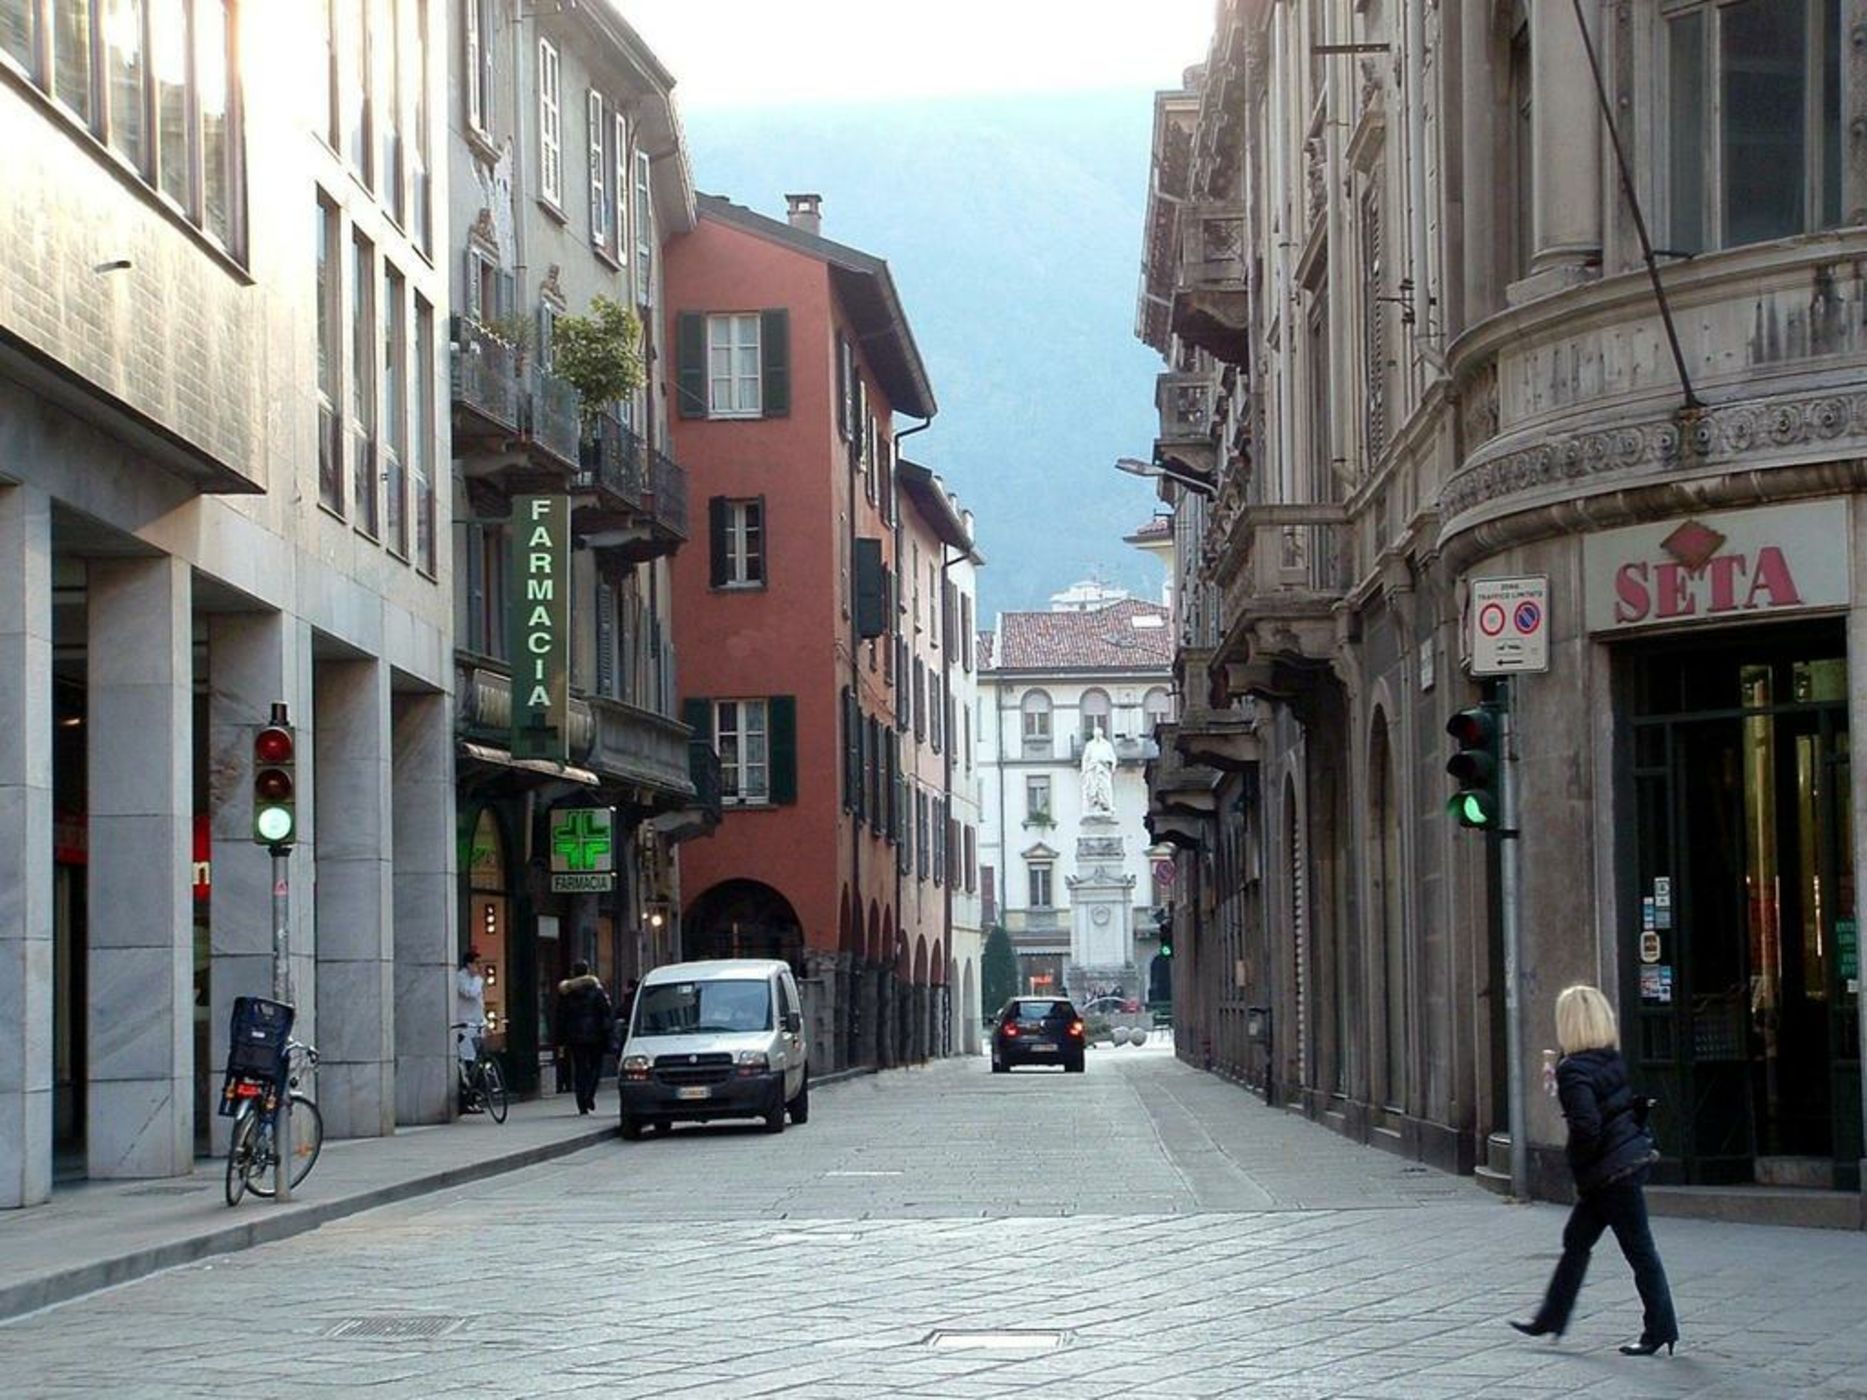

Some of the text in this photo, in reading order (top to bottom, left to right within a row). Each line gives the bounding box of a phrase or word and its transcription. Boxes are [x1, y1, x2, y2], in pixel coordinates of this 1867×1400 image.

[527, 500, 553, 706] FARMACIA
[1615, 546, 1804, 624] SETA
[555, 876, 608, 890] FARMACIA
